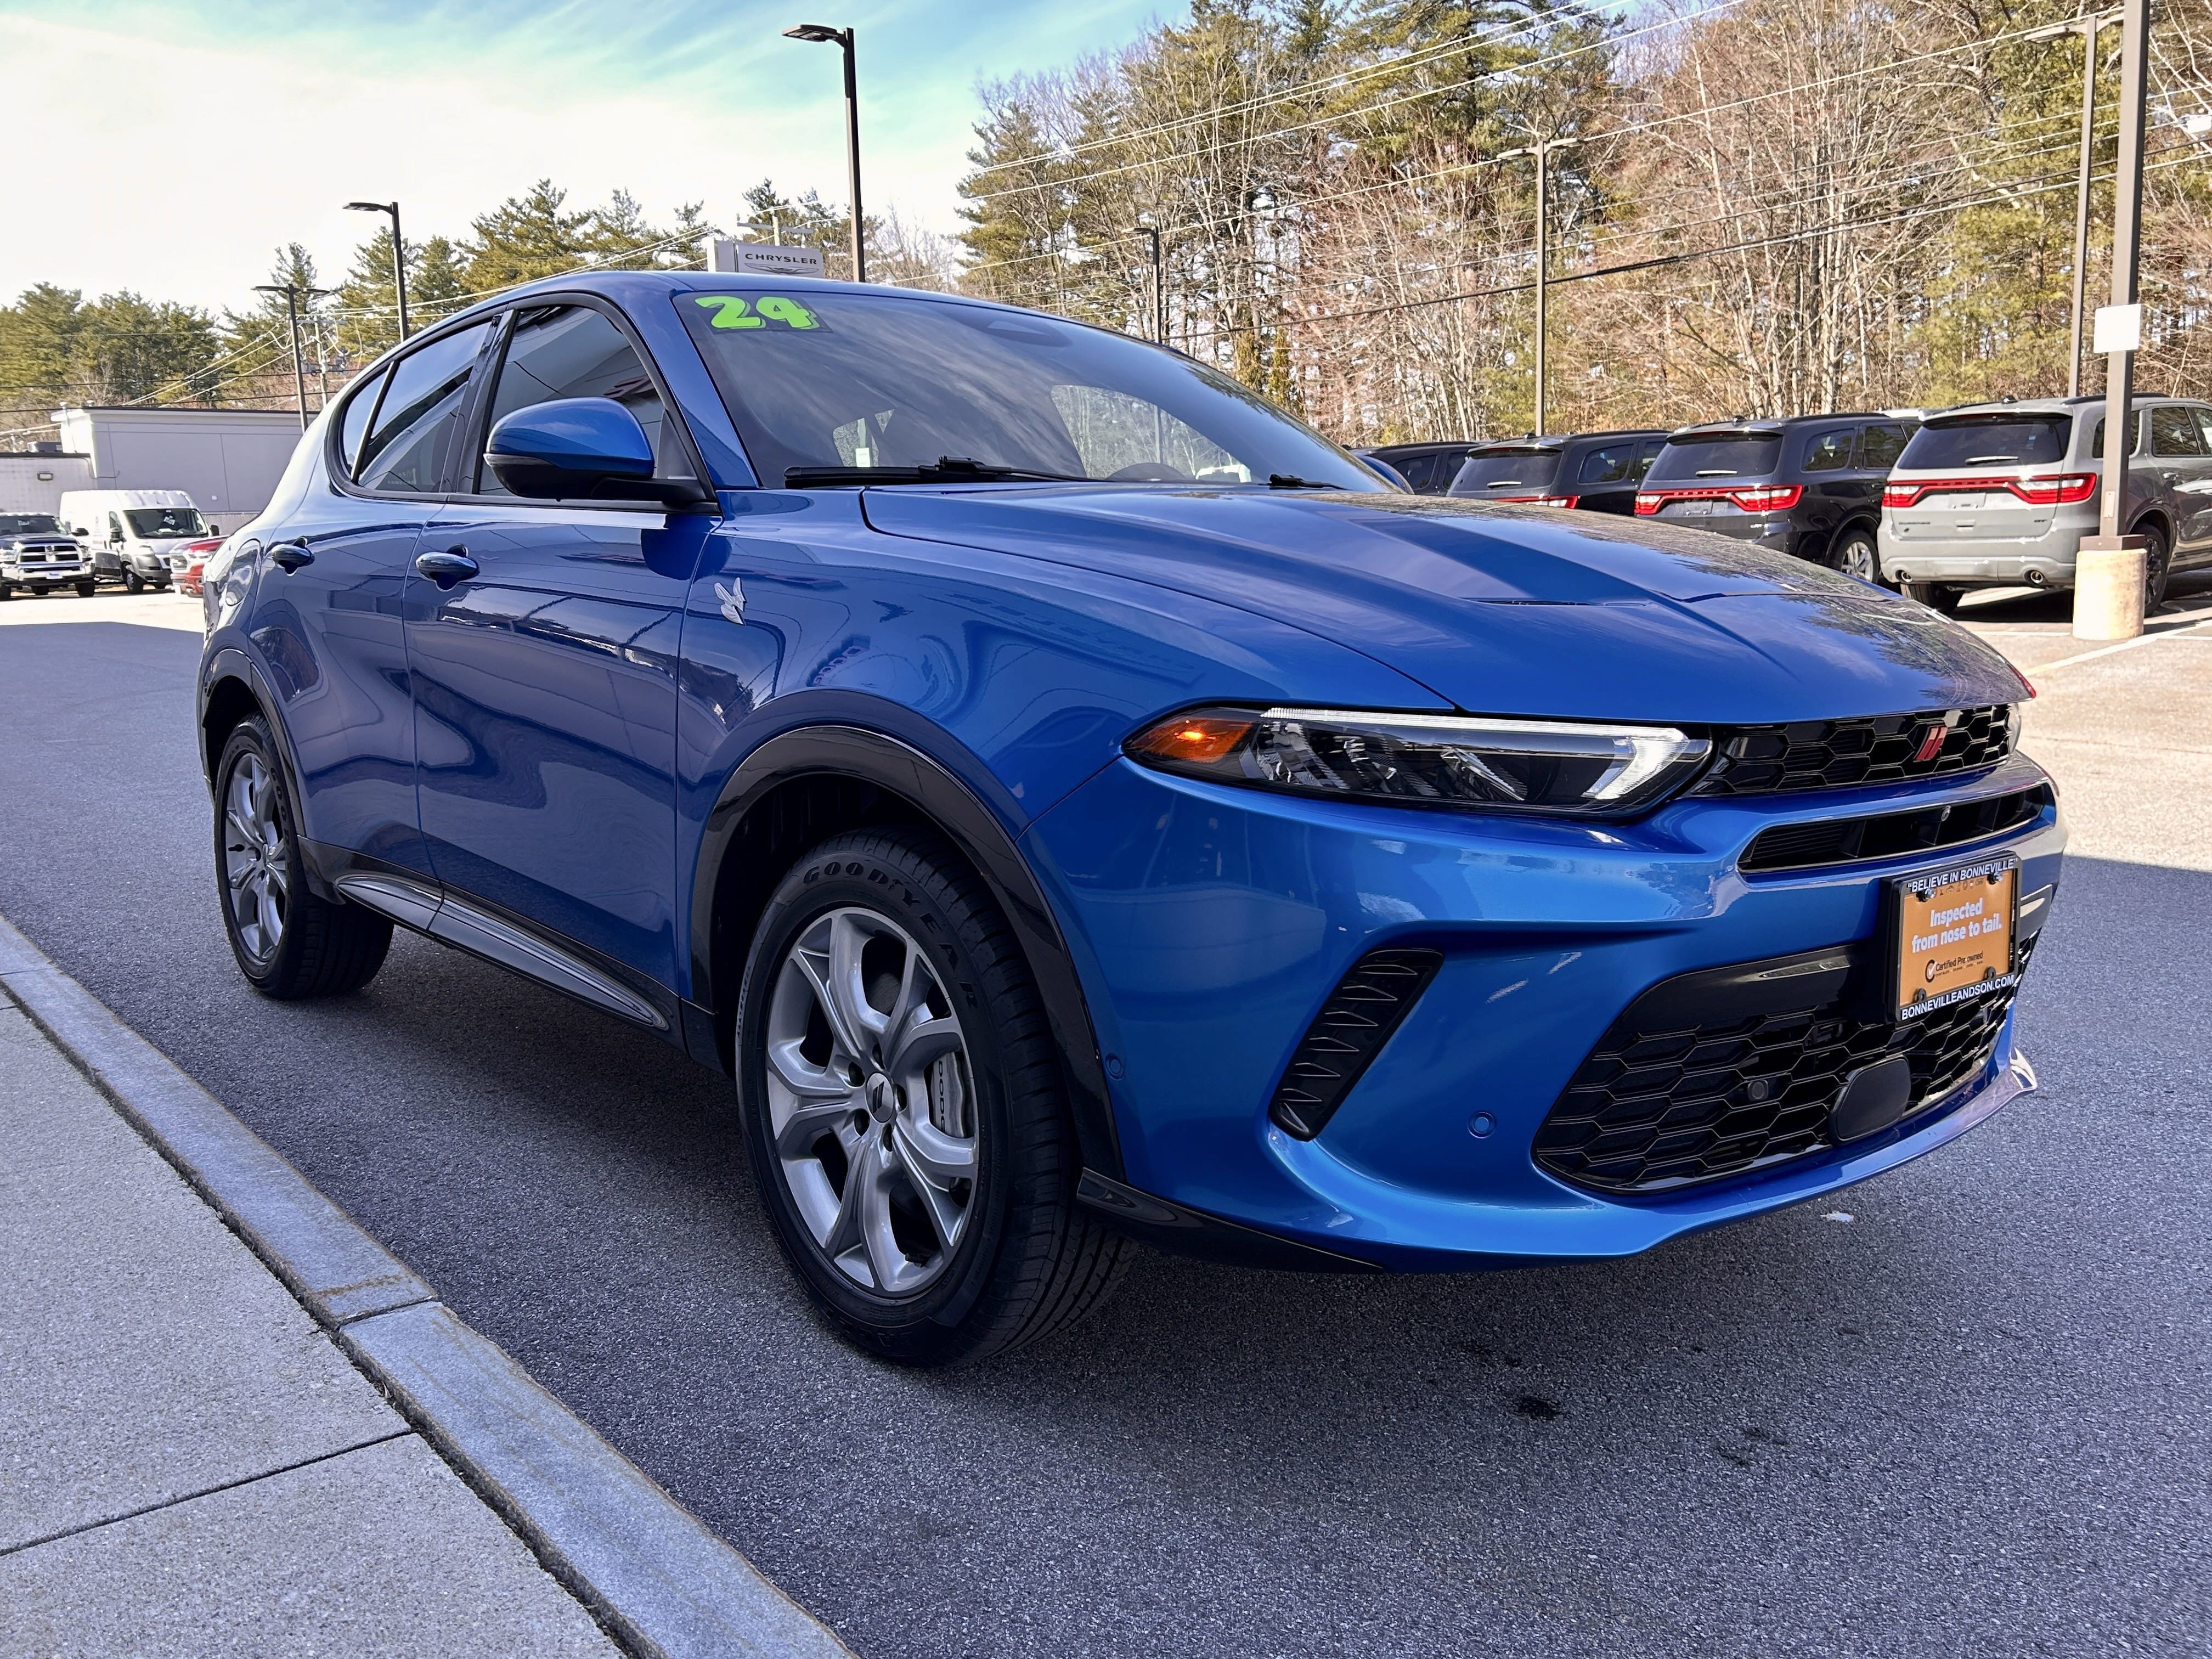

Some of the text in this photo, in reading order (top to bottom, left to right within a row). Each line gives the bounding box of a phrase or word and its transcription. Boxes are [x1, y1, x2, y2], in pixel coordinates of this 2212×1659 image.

[745, 253, 817, 264] CHRYSLER
[695, 296, 820, 329] 24
[1949, 872, 1959, 883] IN
[1930, 898, 1983, 927] Inspected
[804, 861, 978, 1008] GOODYEAR
[1912, 913, 2002, 953] from nose to tail.
[1936, 958, 1956, 971] Certified
[1902, 974, 2015, 1020] BONNEVILLEANDSON.COM
